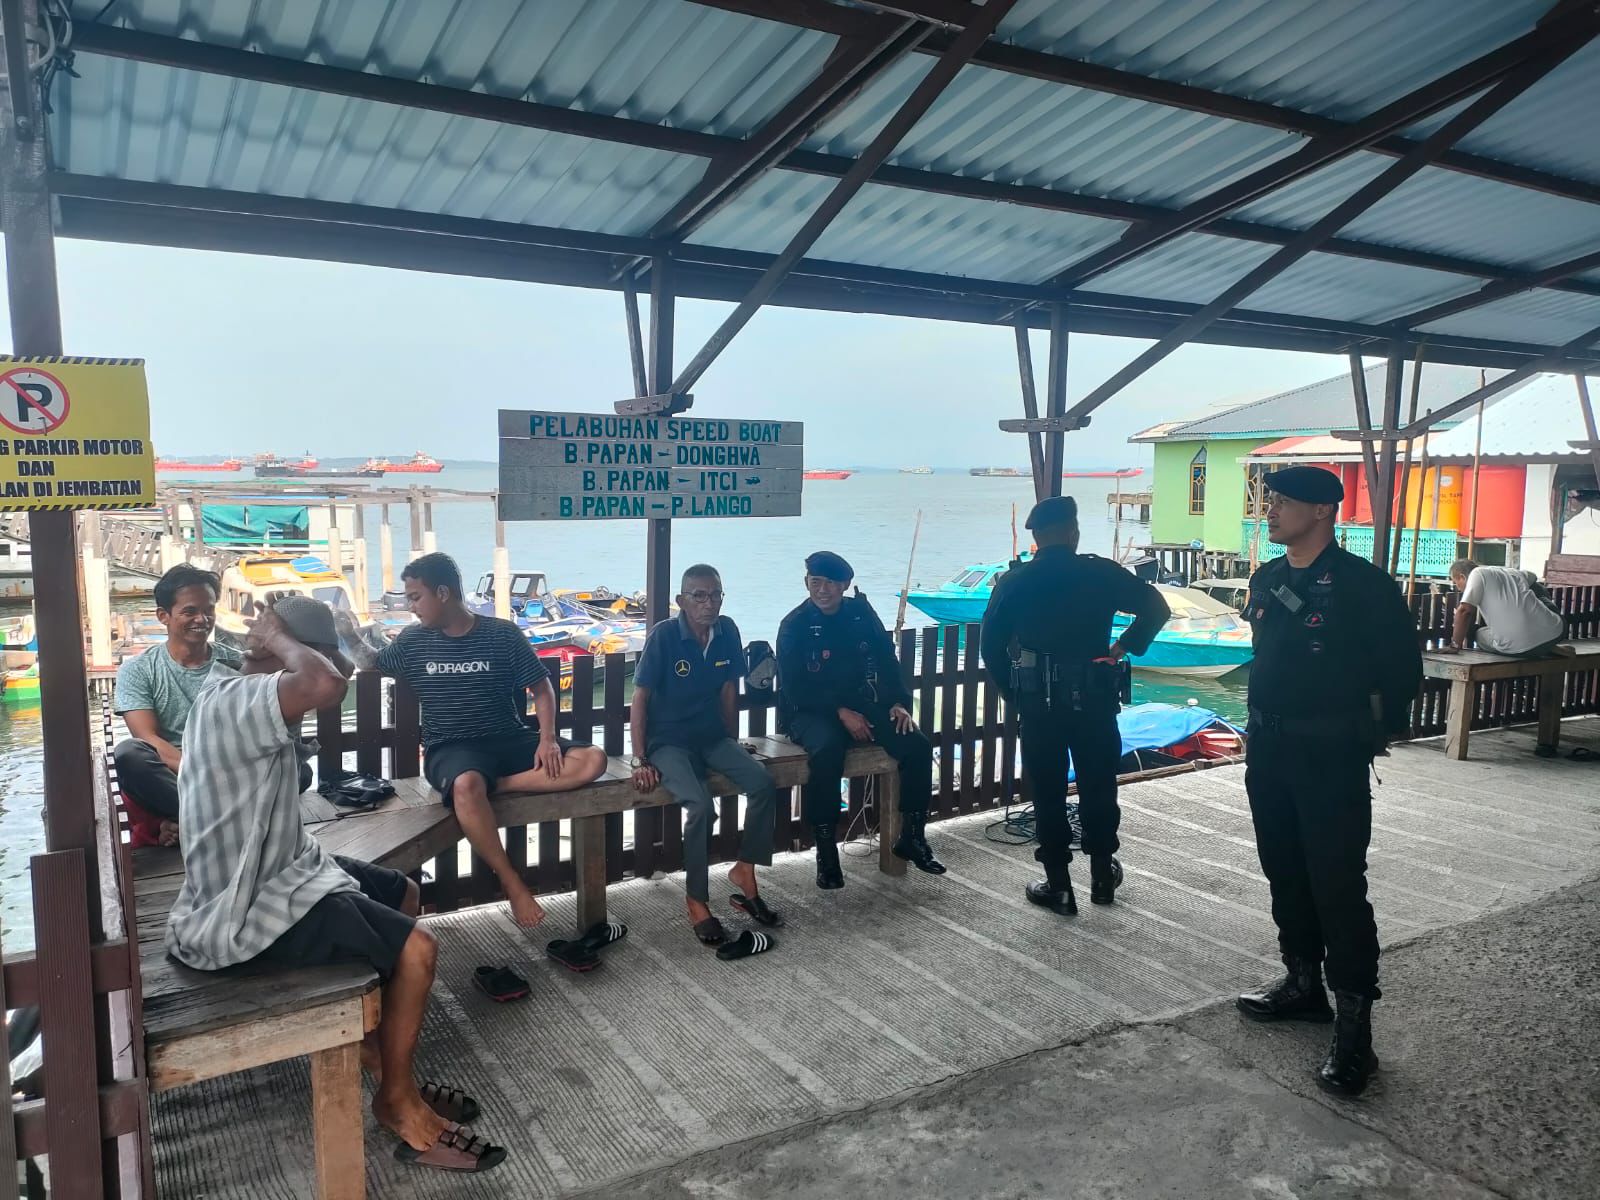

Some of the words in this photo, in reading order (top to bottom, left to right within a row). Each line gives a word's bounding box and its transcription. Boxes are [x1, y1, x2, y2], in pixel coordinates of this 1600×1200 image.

[529, 415, 658, 439] PELABUHAN
[667, 420, 729, 441] SPEED
[739, 422, 782, 442] BOAT
[13, 439, 80, 455] PARKIR
[83, 440, 143, 455] MOTOR
[676, 445, 761, 466] DONGHWA
[17, 461, 55, 476] DAN
[33, 482, 52, 497] DI
[57, 480, 142, 496] JEMBATAN
[700, 471, 737, 491] ITCI
[438, 661, 490, 674] DRAGON
